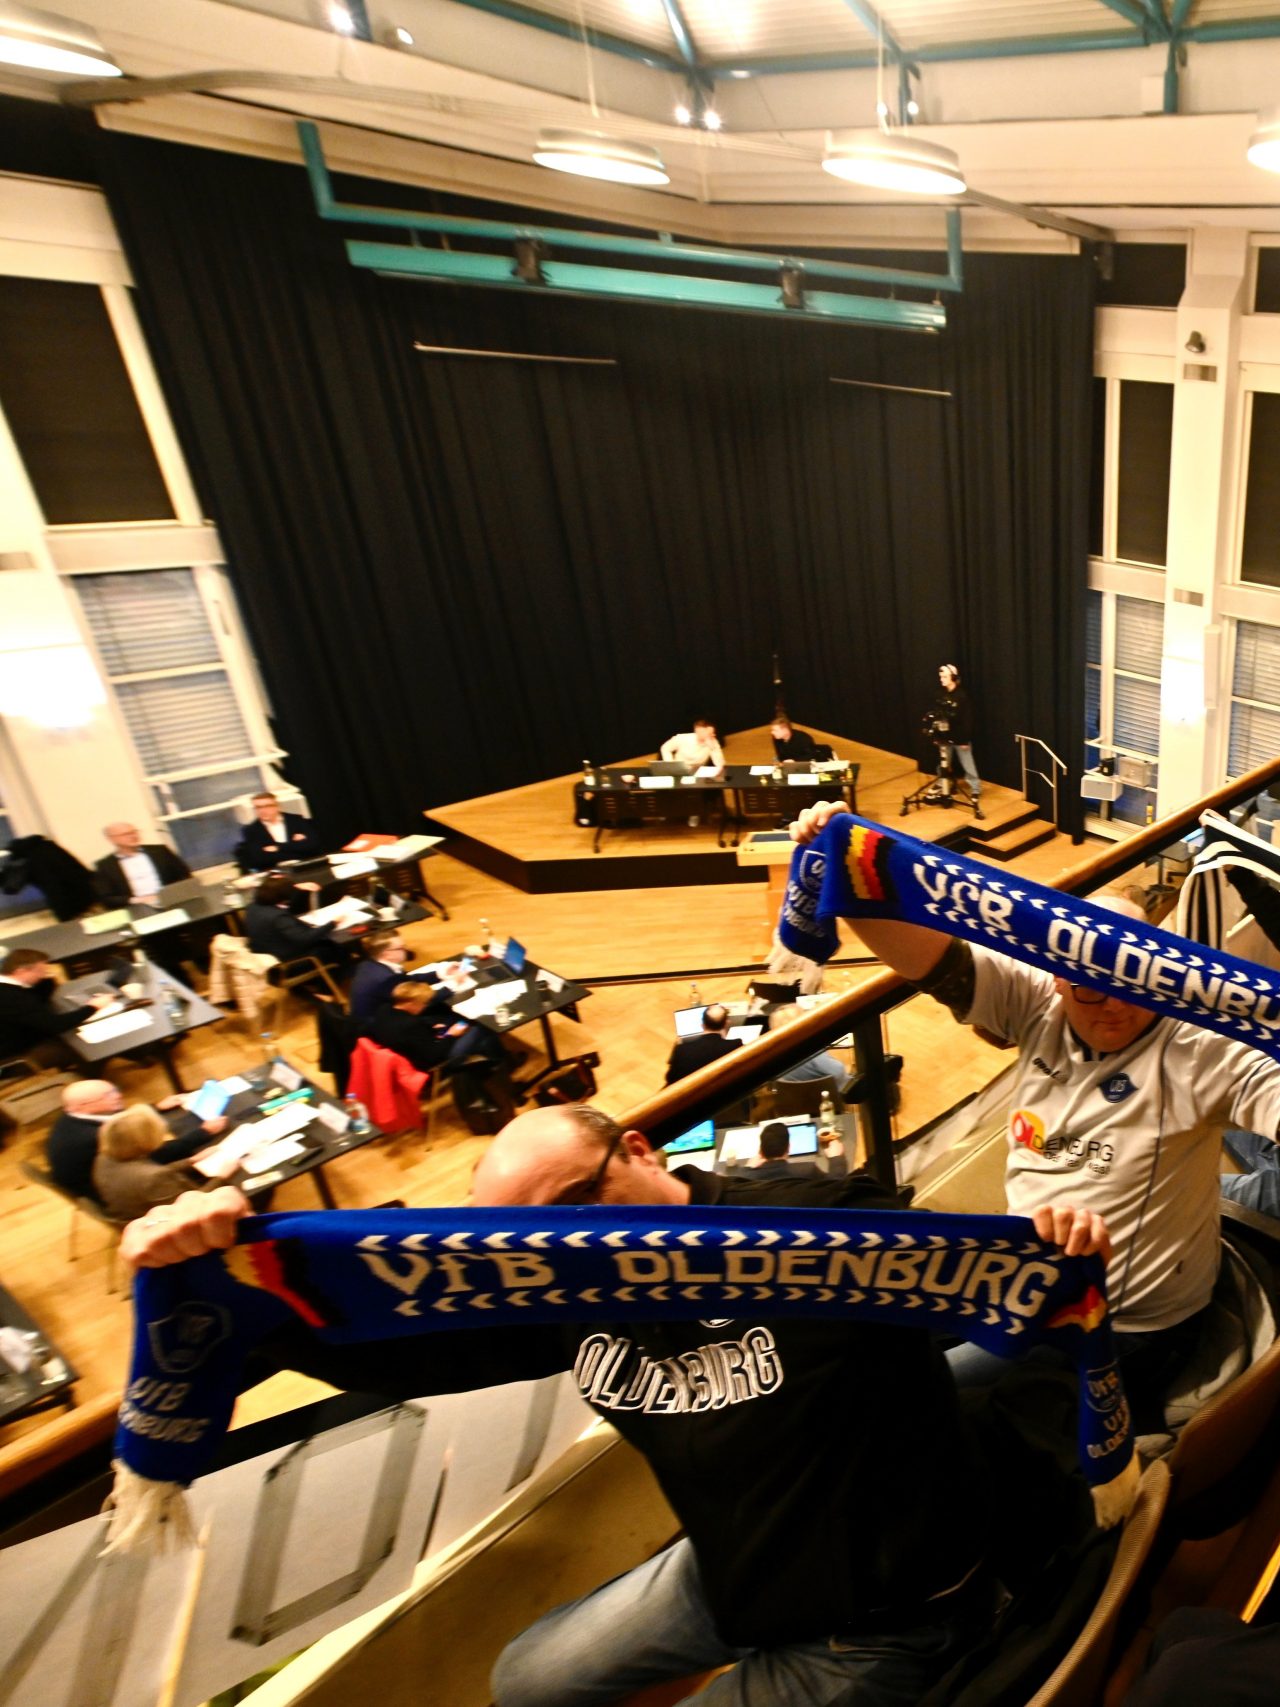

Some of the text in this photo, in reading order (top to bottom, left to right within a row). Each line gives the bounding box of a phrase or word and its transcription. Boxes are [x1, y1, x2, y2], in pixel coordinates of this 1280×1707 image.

[913, 862, 1015, 934] VfB
[358, 1249, 1062, 1318] VfB OLDENBURG
